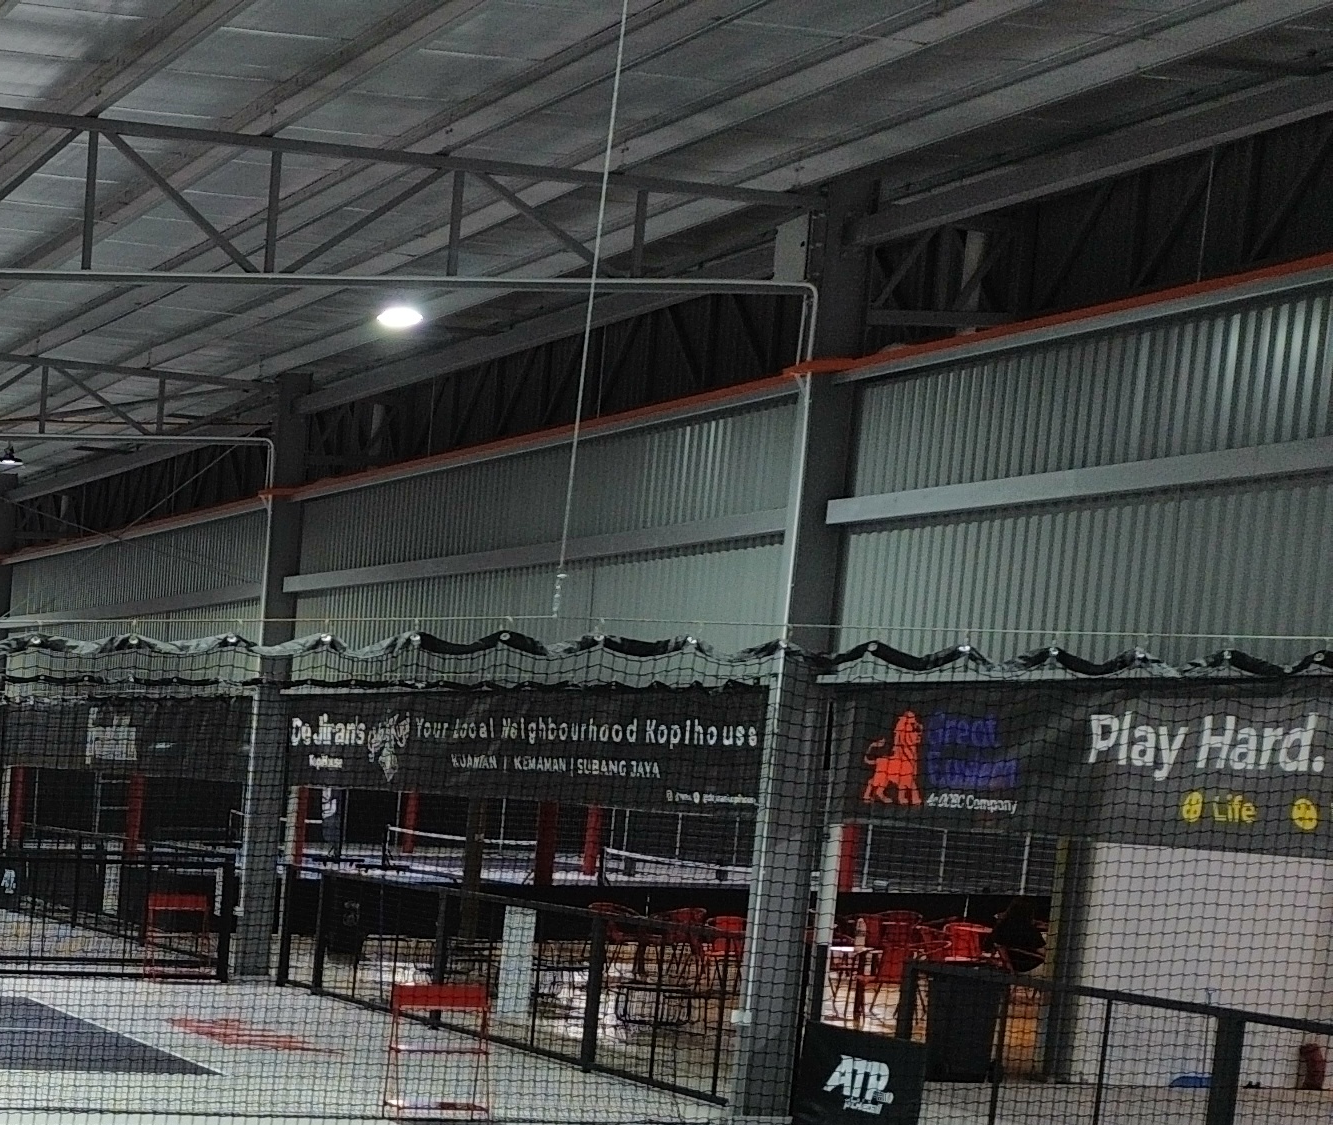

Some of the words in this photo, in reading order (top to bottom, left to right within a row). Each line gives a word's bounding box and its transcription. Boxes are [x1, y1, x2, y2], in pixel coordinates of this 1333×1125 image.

[415, 717, 449, 738] Your
[1088, 710, 1189, 781] Play
[1196, 712, 1325, 773] Hard.
[513, 753, 567, 772] KEMAMAN
[576, 758, 627, 777] SUBANG
[630, 760, 661, 778] JAYA
[966, 794, 1018, 815] Company
[1212, 794, 1257, 823] Life
[822, 1054, 890, 1101] ATP
